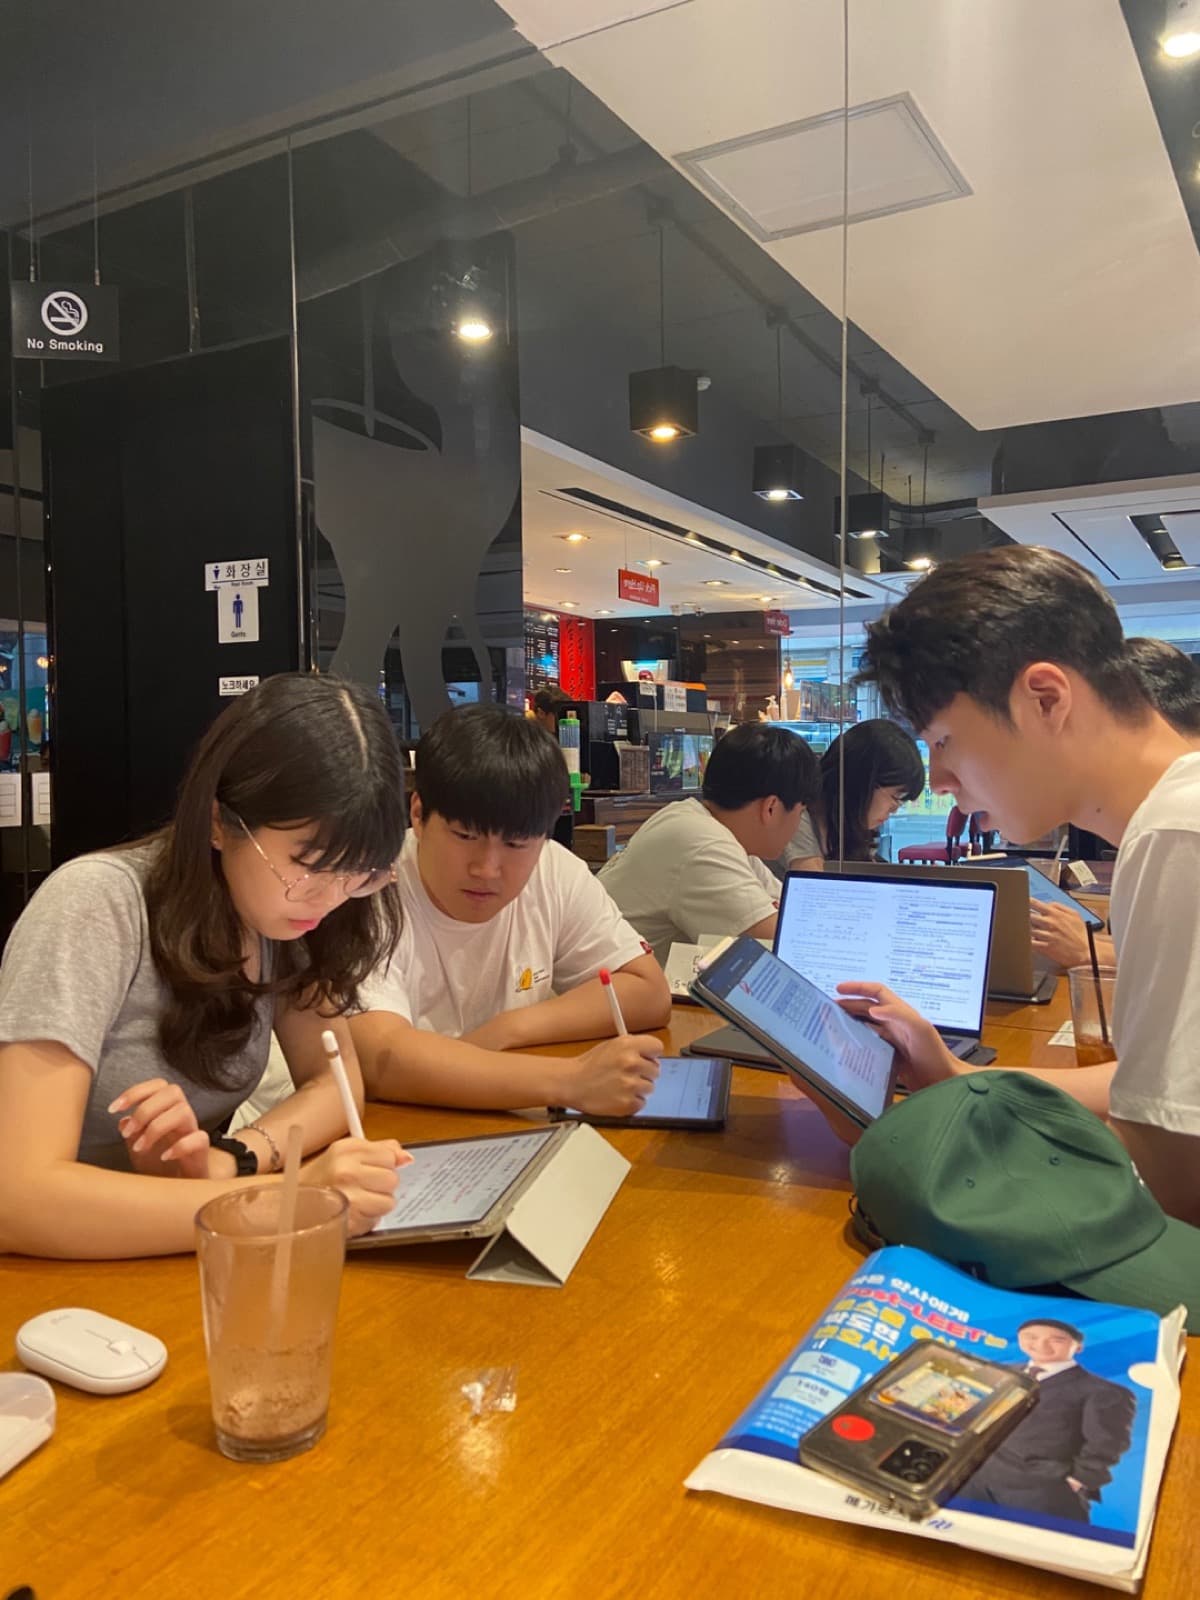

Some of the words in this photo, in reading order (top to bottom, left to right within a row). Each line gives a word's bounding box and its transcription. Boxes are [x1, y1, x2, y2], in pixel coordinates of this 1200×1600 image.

[27, 338, 44, 349] No
[49, 338, 103, 353] Smoking
[225, 560, 266, 579] 화장실
[890, 1277, 970, 1323] 약사에게
